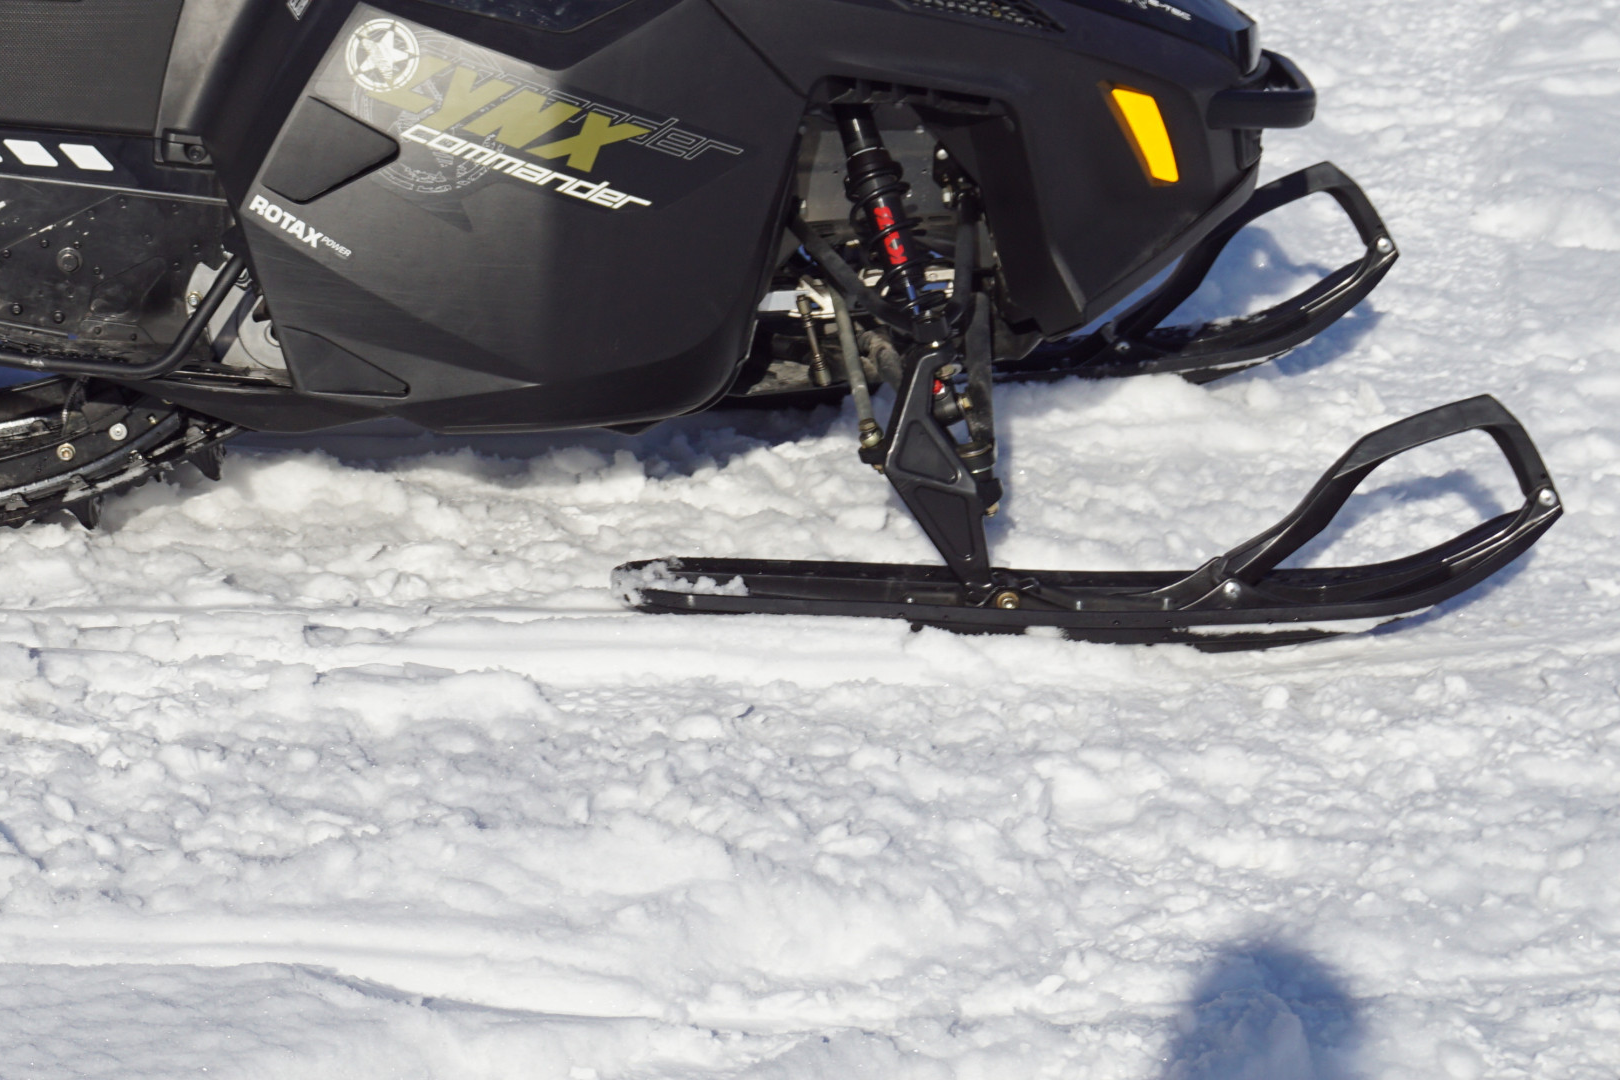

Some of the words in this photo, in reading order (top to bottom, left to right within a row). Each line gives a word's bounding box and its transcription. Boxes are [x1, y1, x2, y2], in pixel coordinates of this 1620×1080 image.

[370, 54, 652, 173] LYNX
[248, 194, 324, 248] ROTAX
[320, 235, 353, 258] POWER
